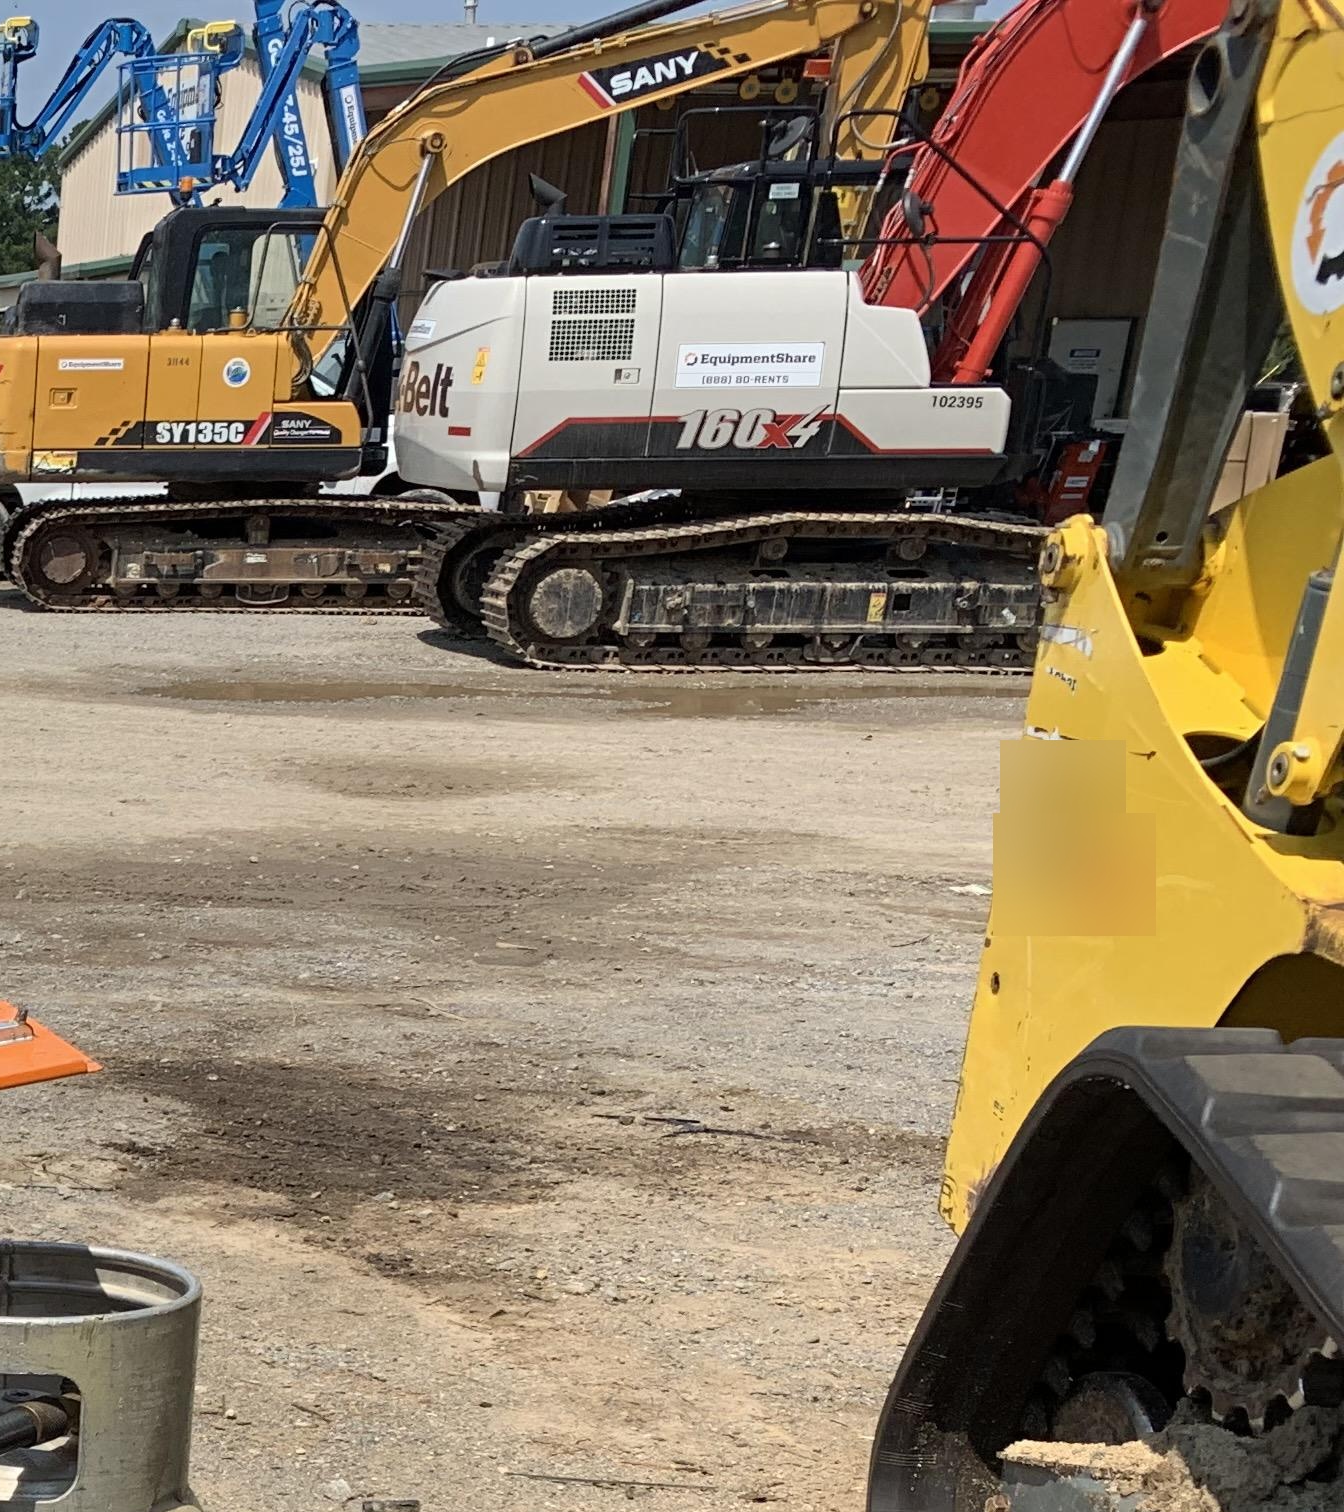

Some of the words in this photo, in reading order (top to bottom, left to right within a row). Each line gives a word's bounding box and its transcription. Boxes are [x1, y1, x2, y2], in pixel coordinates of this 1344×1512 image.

[610, 51, 699, 96] SANY
[700, 352, 816, 366] EquipmentShare
[931, 395, 985, 409] 102395
[280, 419, 313, 429] SANY
[155, 422, 245, 446] SY135C
